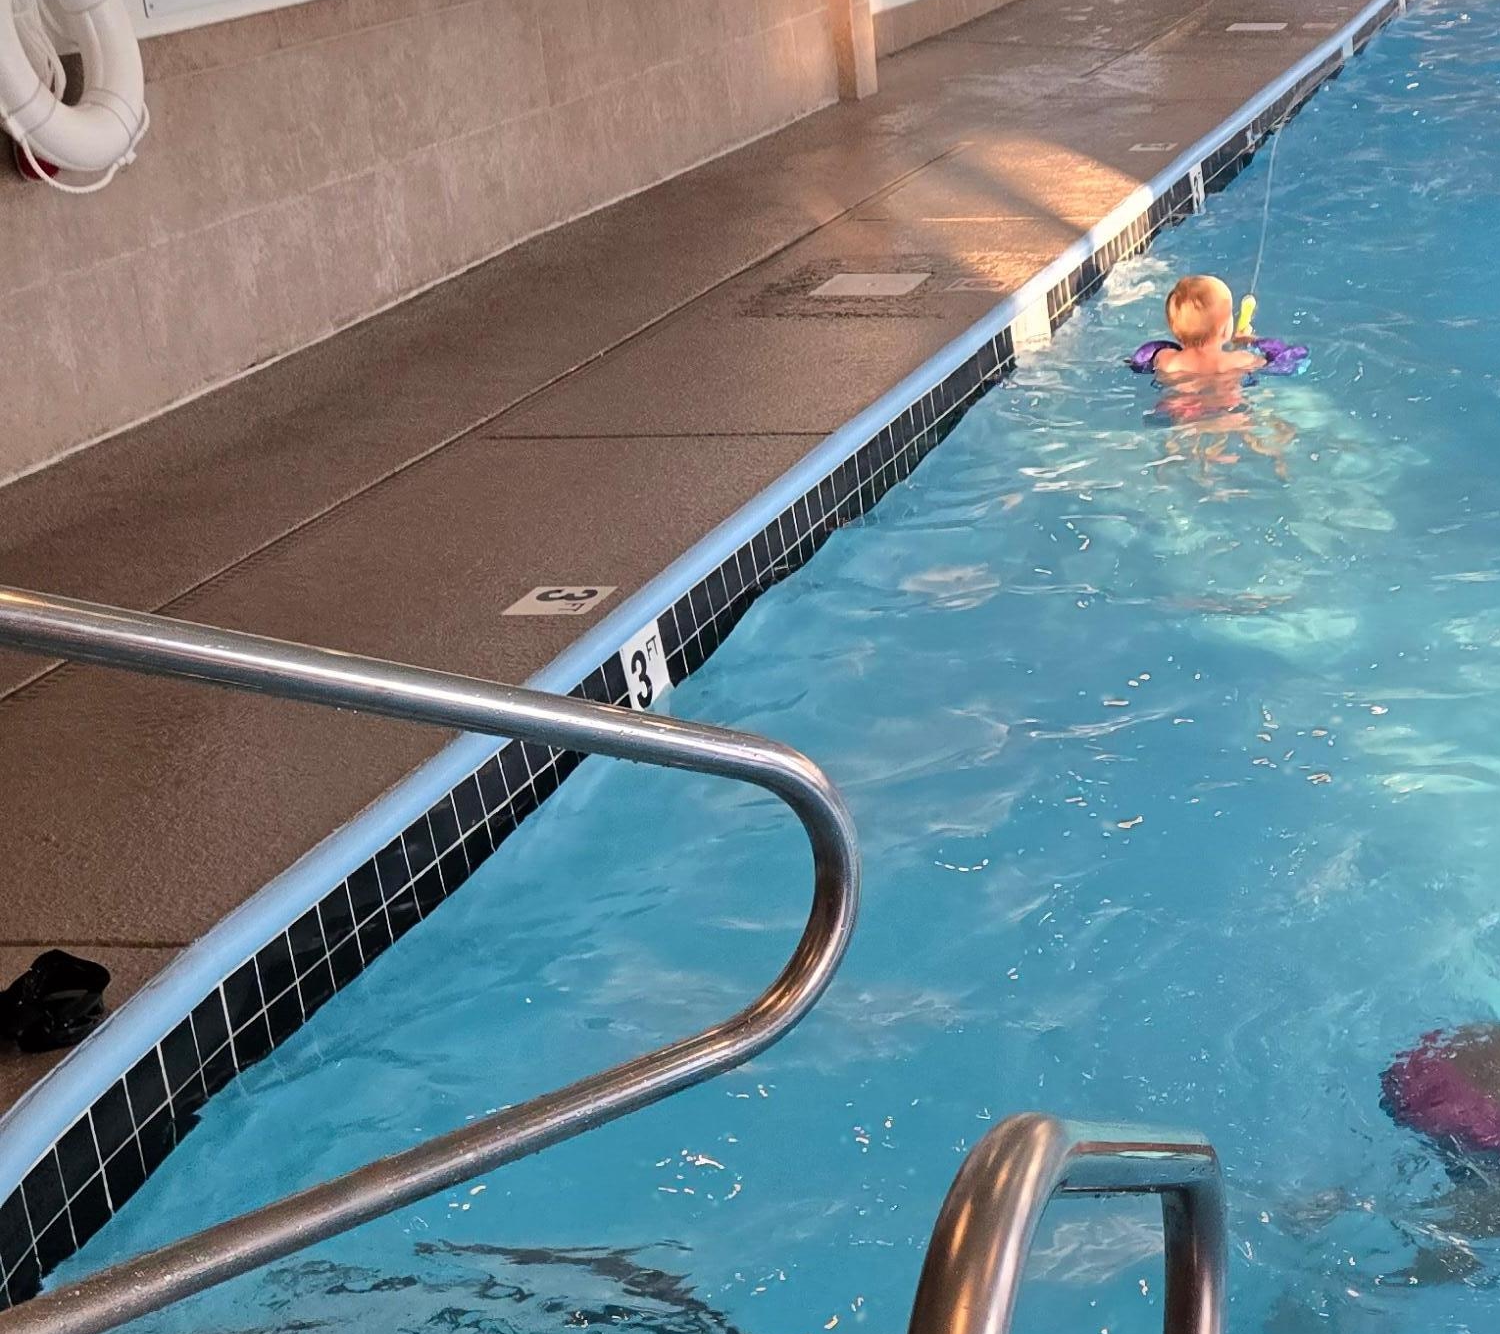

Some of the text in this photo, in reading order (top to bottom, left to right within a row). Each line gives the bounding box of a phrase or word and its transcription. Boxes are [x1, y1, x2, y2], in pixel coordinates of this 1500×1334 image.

[537, 588, 598, 603] 3
[630, 634, 659, 709] 3 FT
